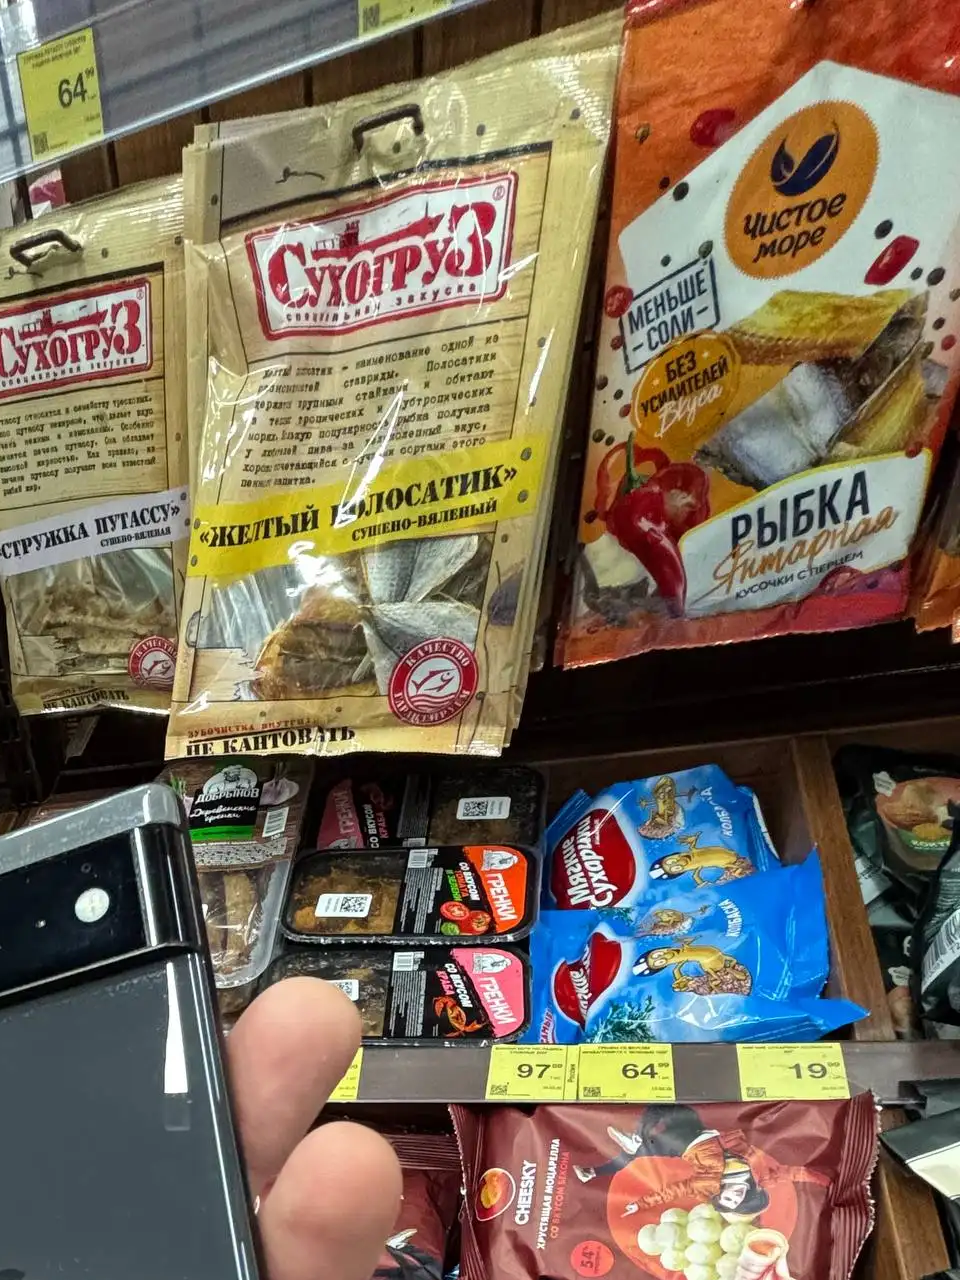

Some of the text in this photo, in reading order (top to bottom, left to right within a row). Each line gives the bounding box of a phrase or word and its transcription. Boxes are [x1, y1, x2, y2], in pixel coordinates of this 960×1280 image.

[58, 72, 87, 109] 64
[396, 282, 477, 306] закуска
[628, 268, 708, 335] МЕНЬШЕ
[646, 306, 695, 352] СОЛИ
[343, 370, 400, 389] ставриды.
[426, 352, 497, 373] Полосатики
[355, 334, 500, 370] наименование одной из
[665, 350, 697, 383] БЕЗ
[355, 382, 409, 401] стайками
[445, 369, 495, 386] обитают
[640, 354, 730, 418] УСИЛИТЕЛЕЙ
[298, 408, 365, 428] тропических
[400, 386, 494, 410] убтропических
[396, 413, 430, 426] рыбка
[437, 403, 490, 419] получила
[342, 441, 355, 450] за
[454, 423, 488, 436] вкус,
[400, 441, 446, 455] сортами
[452, 436, 486, 449] этого
[94, 502, 180, 535] ПУТАССУ»
[200, 506, 320, 548] «ЖЕЛТЫЙ
[351, 498, 498, 541] СУШЕНО-ВЯЛЕНЫЙ
[730, 469, 871, 557] РЫБКА
[100, 526, 171, 548] СУШЕНО-ВЯЛЕНАЯ
[735, 550, 864, 600] КУСОЧКИ С ПЕРЦЕМ
[405, 641, 471, 668] КАЧЕСТВО
[186, 726, 356, 756] НЕ КАНТОВАТЬ
[188, 721, 255, 739] ЗУБОЧИСТКА
[194, 787, 260, 805] ДОБРЫНОВ
[363, 803, 380, 848] СО ВКУСОМ
[458, 861, 470, 871] СО
[562, 835, 589, 907] Мягкие
[576, 815, 618, 910] Сухарики
[487, 872, 519, 922] ГРЕНКИ
[720, 898, 742, 938] КОЛБАСКА
[435, 970, 456, 996] КРАБА
[444, 963, 474, 1009] СО ВКУСОМ
[479, 976, 519, 1026] ГРЕНКИ
[517, 1063, 551, 1079] 97
[622, 1063, 658, 1079] 64
[788, 1063, 828, 1080] 19
[514, 1160, 537, 1226] CHEESKY
[536, 1138, 561, 1250] ХРУСТЯЩАЯ МОЦАРЕЛЛА
[550, 1151, 570, 1239] СО ВКУСОМ БЕКОНА
